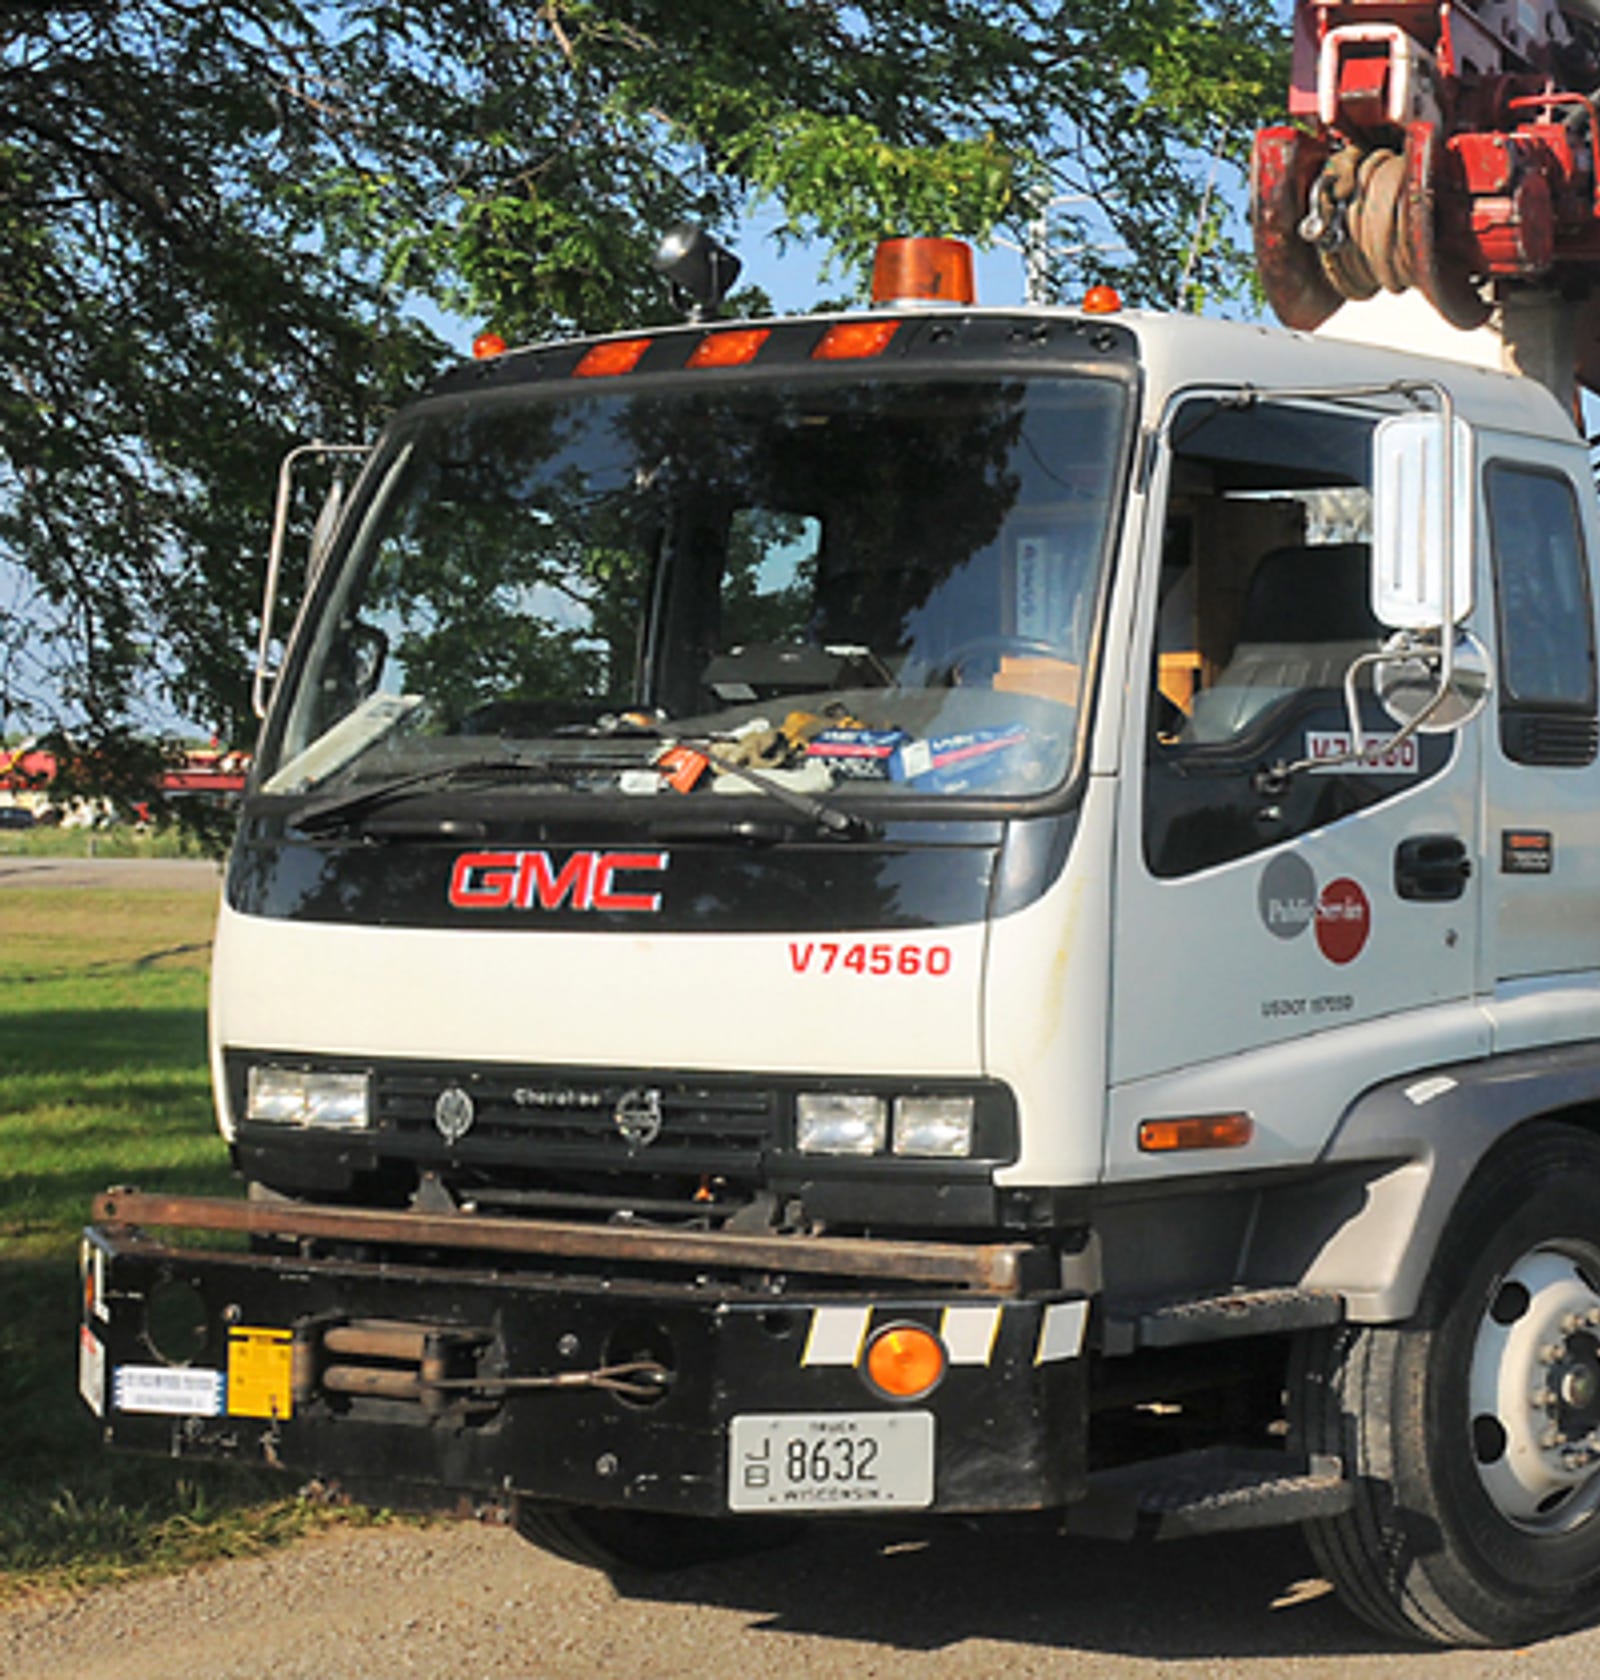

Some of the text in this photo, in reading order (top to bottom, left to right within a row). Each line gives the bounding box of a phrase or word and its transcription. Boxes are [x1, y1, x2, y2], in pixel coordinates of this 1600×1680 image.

[449, 851, 670, 911] GMC
[788, 943, 951, 976] V74560
[787, 1437, 877, 1483] 8632
